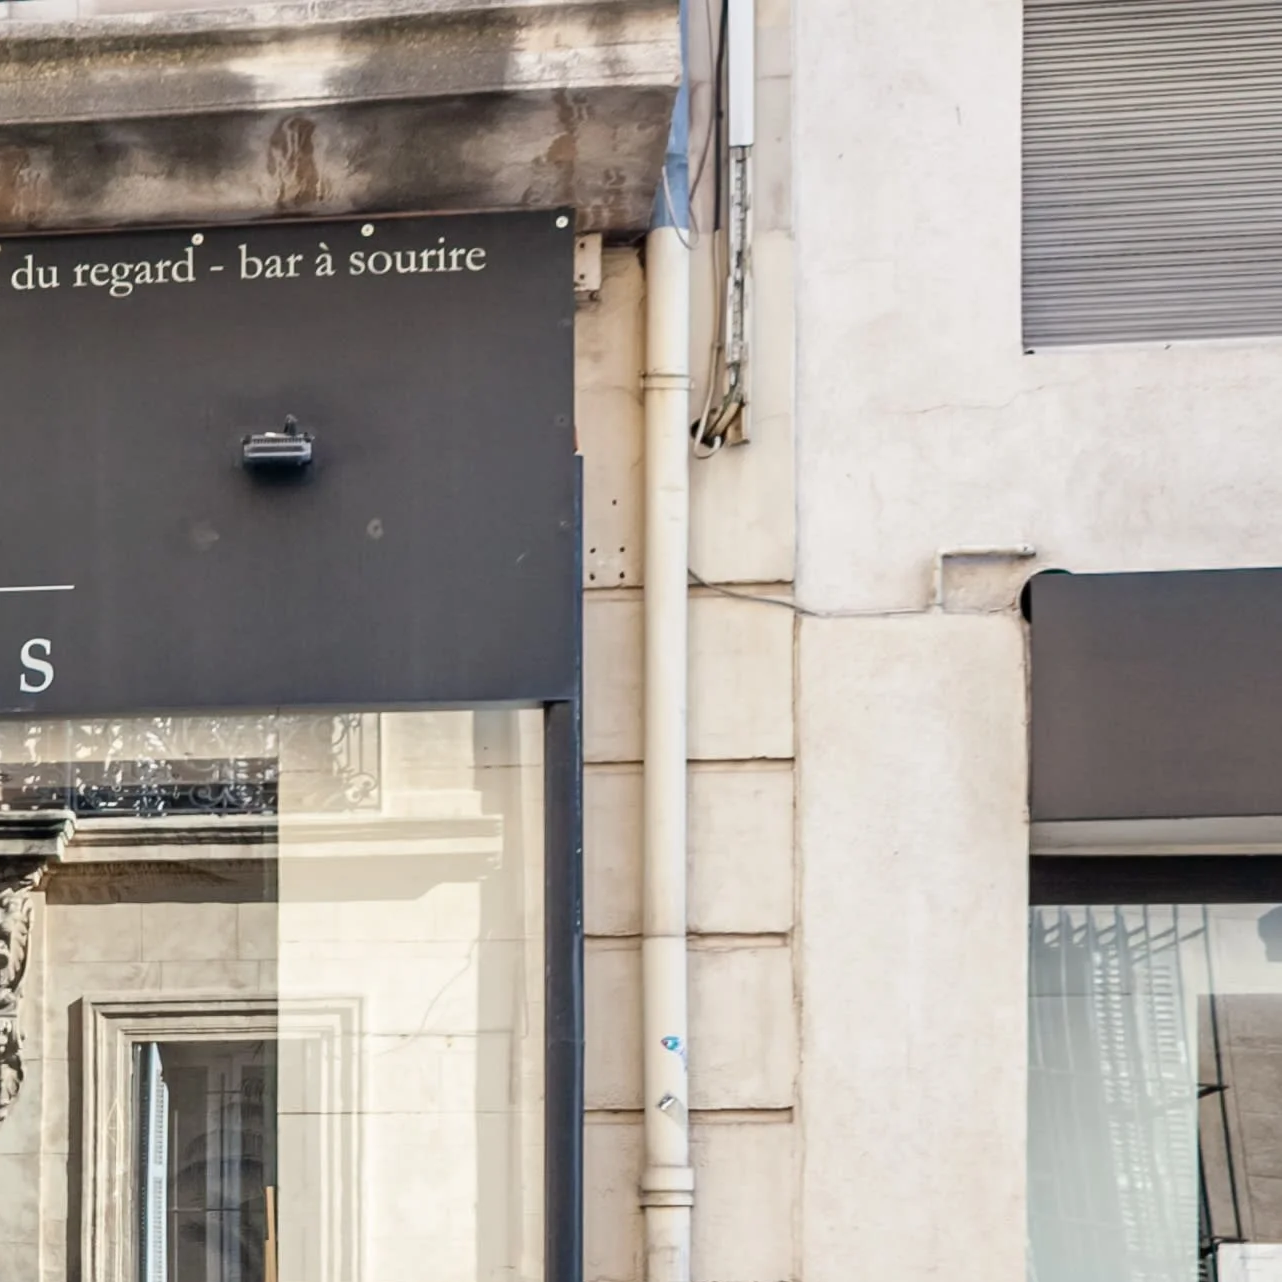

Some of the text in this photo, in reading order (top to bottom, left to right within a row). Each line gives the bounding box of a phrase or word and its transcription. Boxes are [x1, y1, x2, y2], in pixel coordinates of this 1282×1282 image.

[11, 254, 60, 290] du
[73, 246, 196, 297] regard
[239, 244, 303, 279] bar
[315, 242, 335, 277] à
[349, 237, 486, 276] sourire
